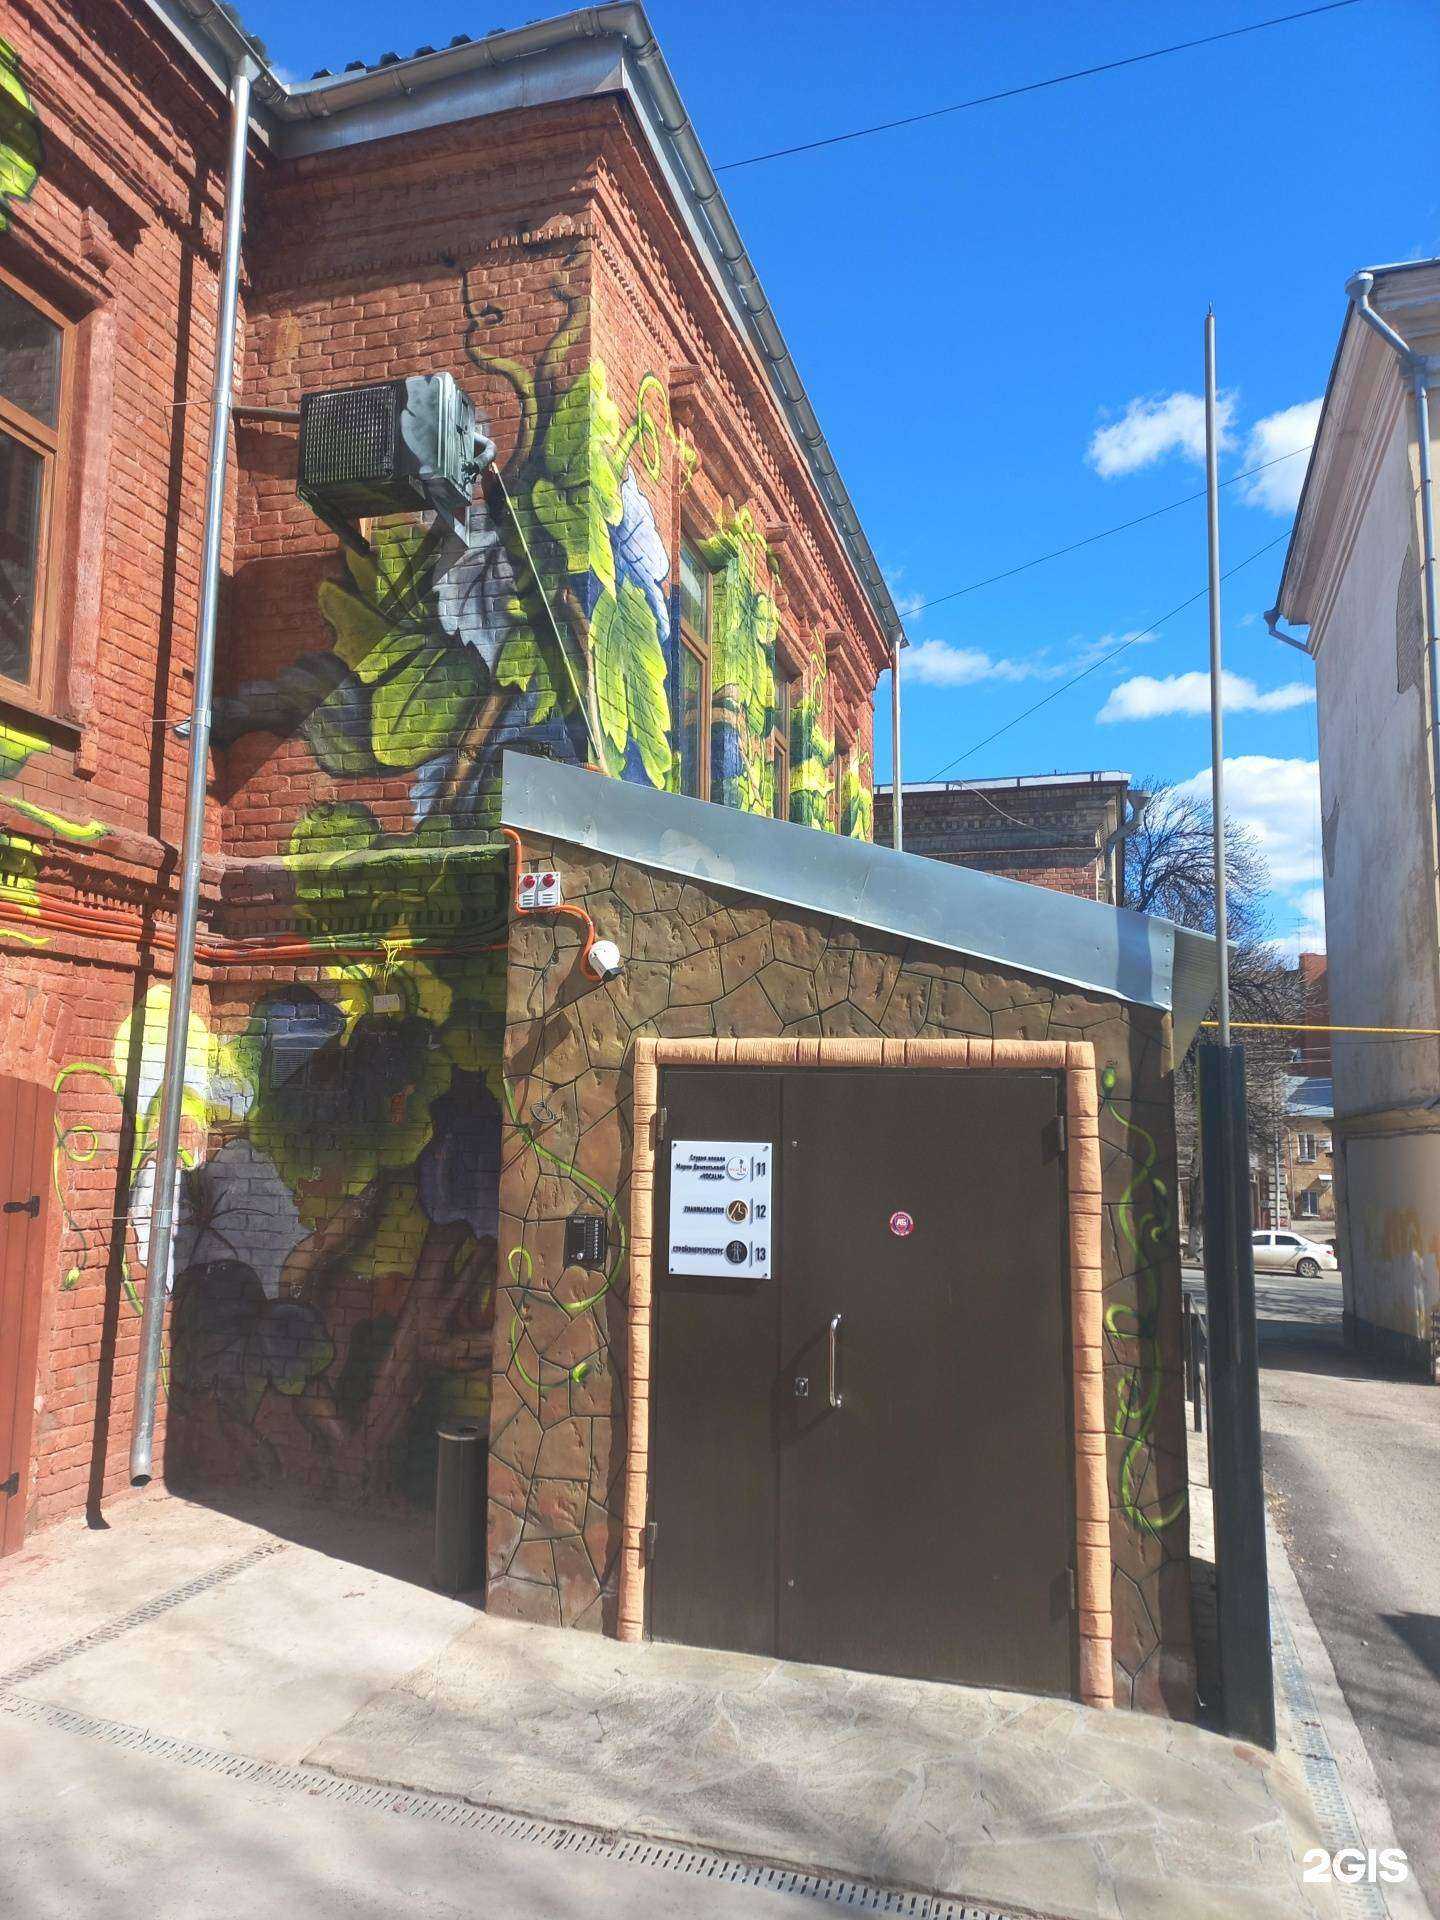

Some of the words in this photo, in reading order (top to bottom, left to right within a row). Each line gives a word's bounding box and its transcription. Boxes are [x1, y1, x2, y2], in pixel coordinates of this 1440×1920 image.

[690, 1154, 707, 1162] Студия
[756, 1162, 766, 1176] 11
[756, 1205, 766, 1218] 12
[756, 1247, 766, 1261] 13
